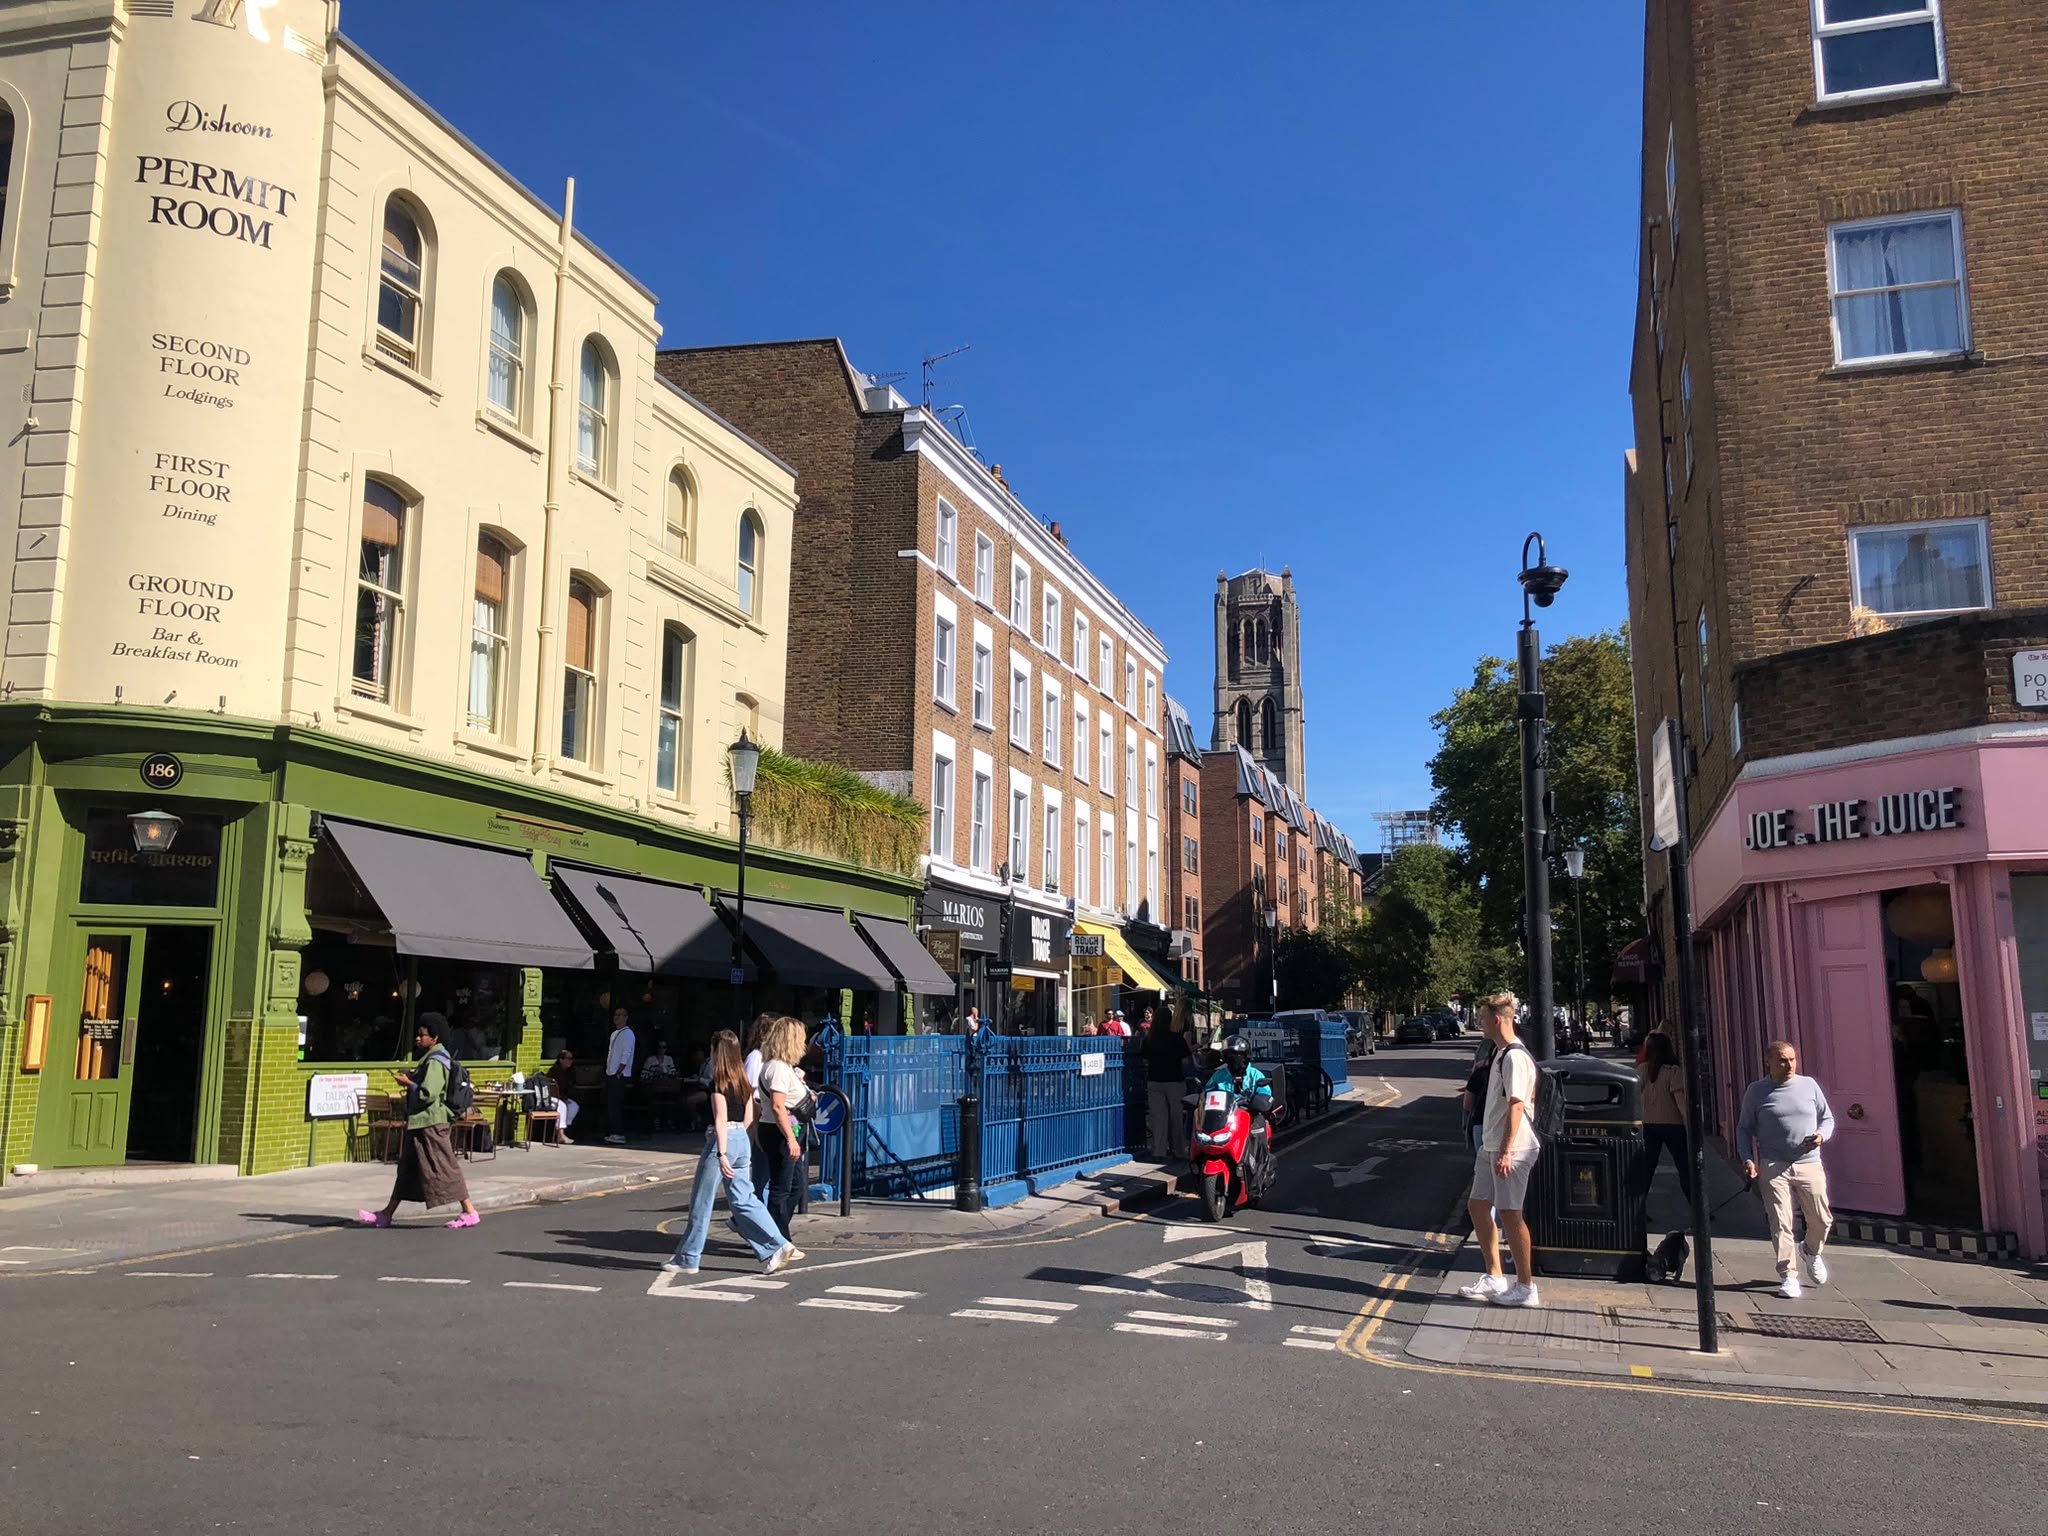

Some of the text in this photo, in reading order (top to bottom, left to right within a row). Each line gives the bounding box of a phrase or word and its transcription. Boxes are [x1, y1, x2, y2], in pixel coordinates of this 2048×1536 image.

[166, 100, 273, 139] Dishoom
[134, 155, 297, 218] PERMIT
[148, 195, 274, 250] ROOM
[152, 333, 251, 366] SECOND
[159, 356, 240, 386] FLOOR
[163, 384, 234, 409] Lodgings
[154, 453, 230, 479] FIRST
[149, 475, 231, 503] FLOOR
[162, 504, 218, 526] Dining
[128, 574, 234, 602] GROUND
[137, 598, 221, 623] FLOOR
[151, 627, 204, 645] Bar &
[111, 642, 239, 669] Breakfast Room
[2024, 674, 2047, 687] PO
[148, 763, 175, 778] 186
[1745, 787, 1957, 849] JOE & THE JUICE
[943, 900, 984, 928] MARIOS
[1031, 915, 1050, 940] ROUGH
[1031, 938, 1051, 963] TRADE
[1074, 936, 1099, 945] ROUGH
[1074, 945, 1099, 955] TRADE
[316, 1102, 341, 1113] ROAD
[1209, 1095, 1220, 1106] L
[1569, 1127, 1608, 1136] ITTER
